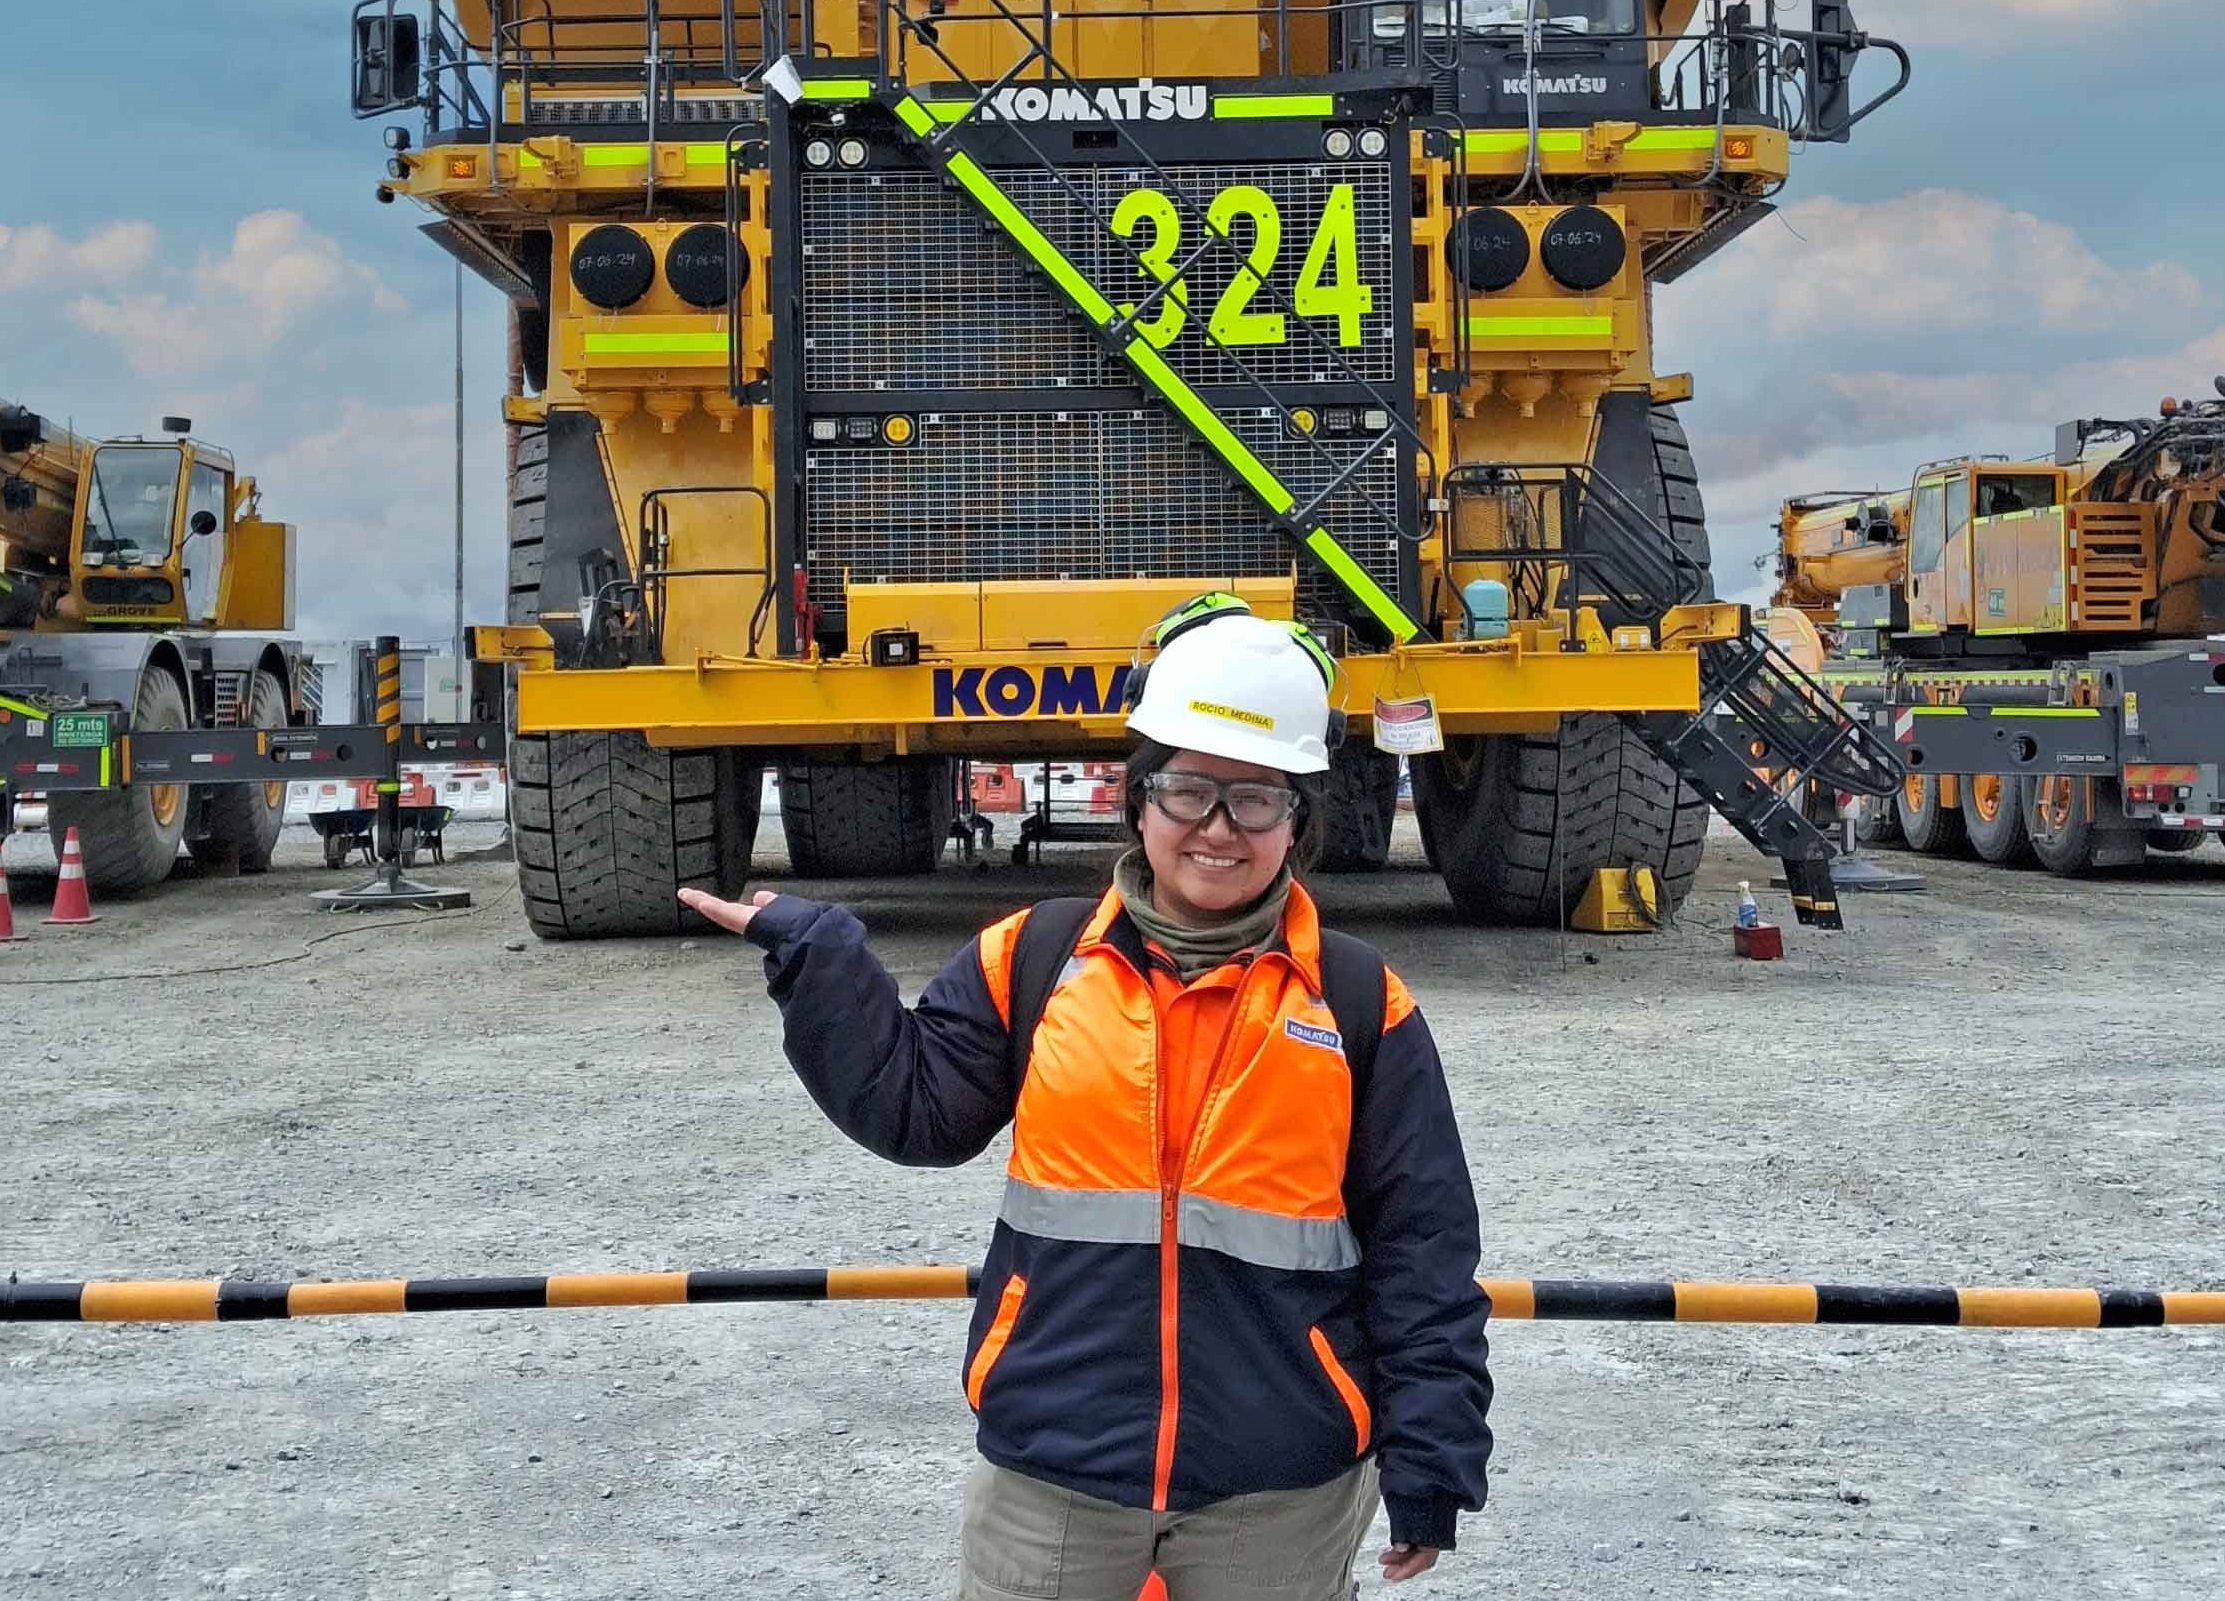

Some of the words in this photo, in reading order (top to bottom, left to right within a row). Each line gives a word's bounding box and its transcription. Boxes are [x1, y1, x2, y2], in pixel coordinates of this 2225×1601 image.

[1503, 74, 1607, 94] KOMATSU
[981, 78, 1207, 122] KOMATSU
[1111, 184, 1372, 349] 324
[57, 718, 75, 731] 25
[78, 718, 104, 731] mts
[1192, 701, 1225, 715] ROCIO
[1230, 709, 1270, 727] MEDINA
[1290, 1023, 1336, 1045] KOMATSU
